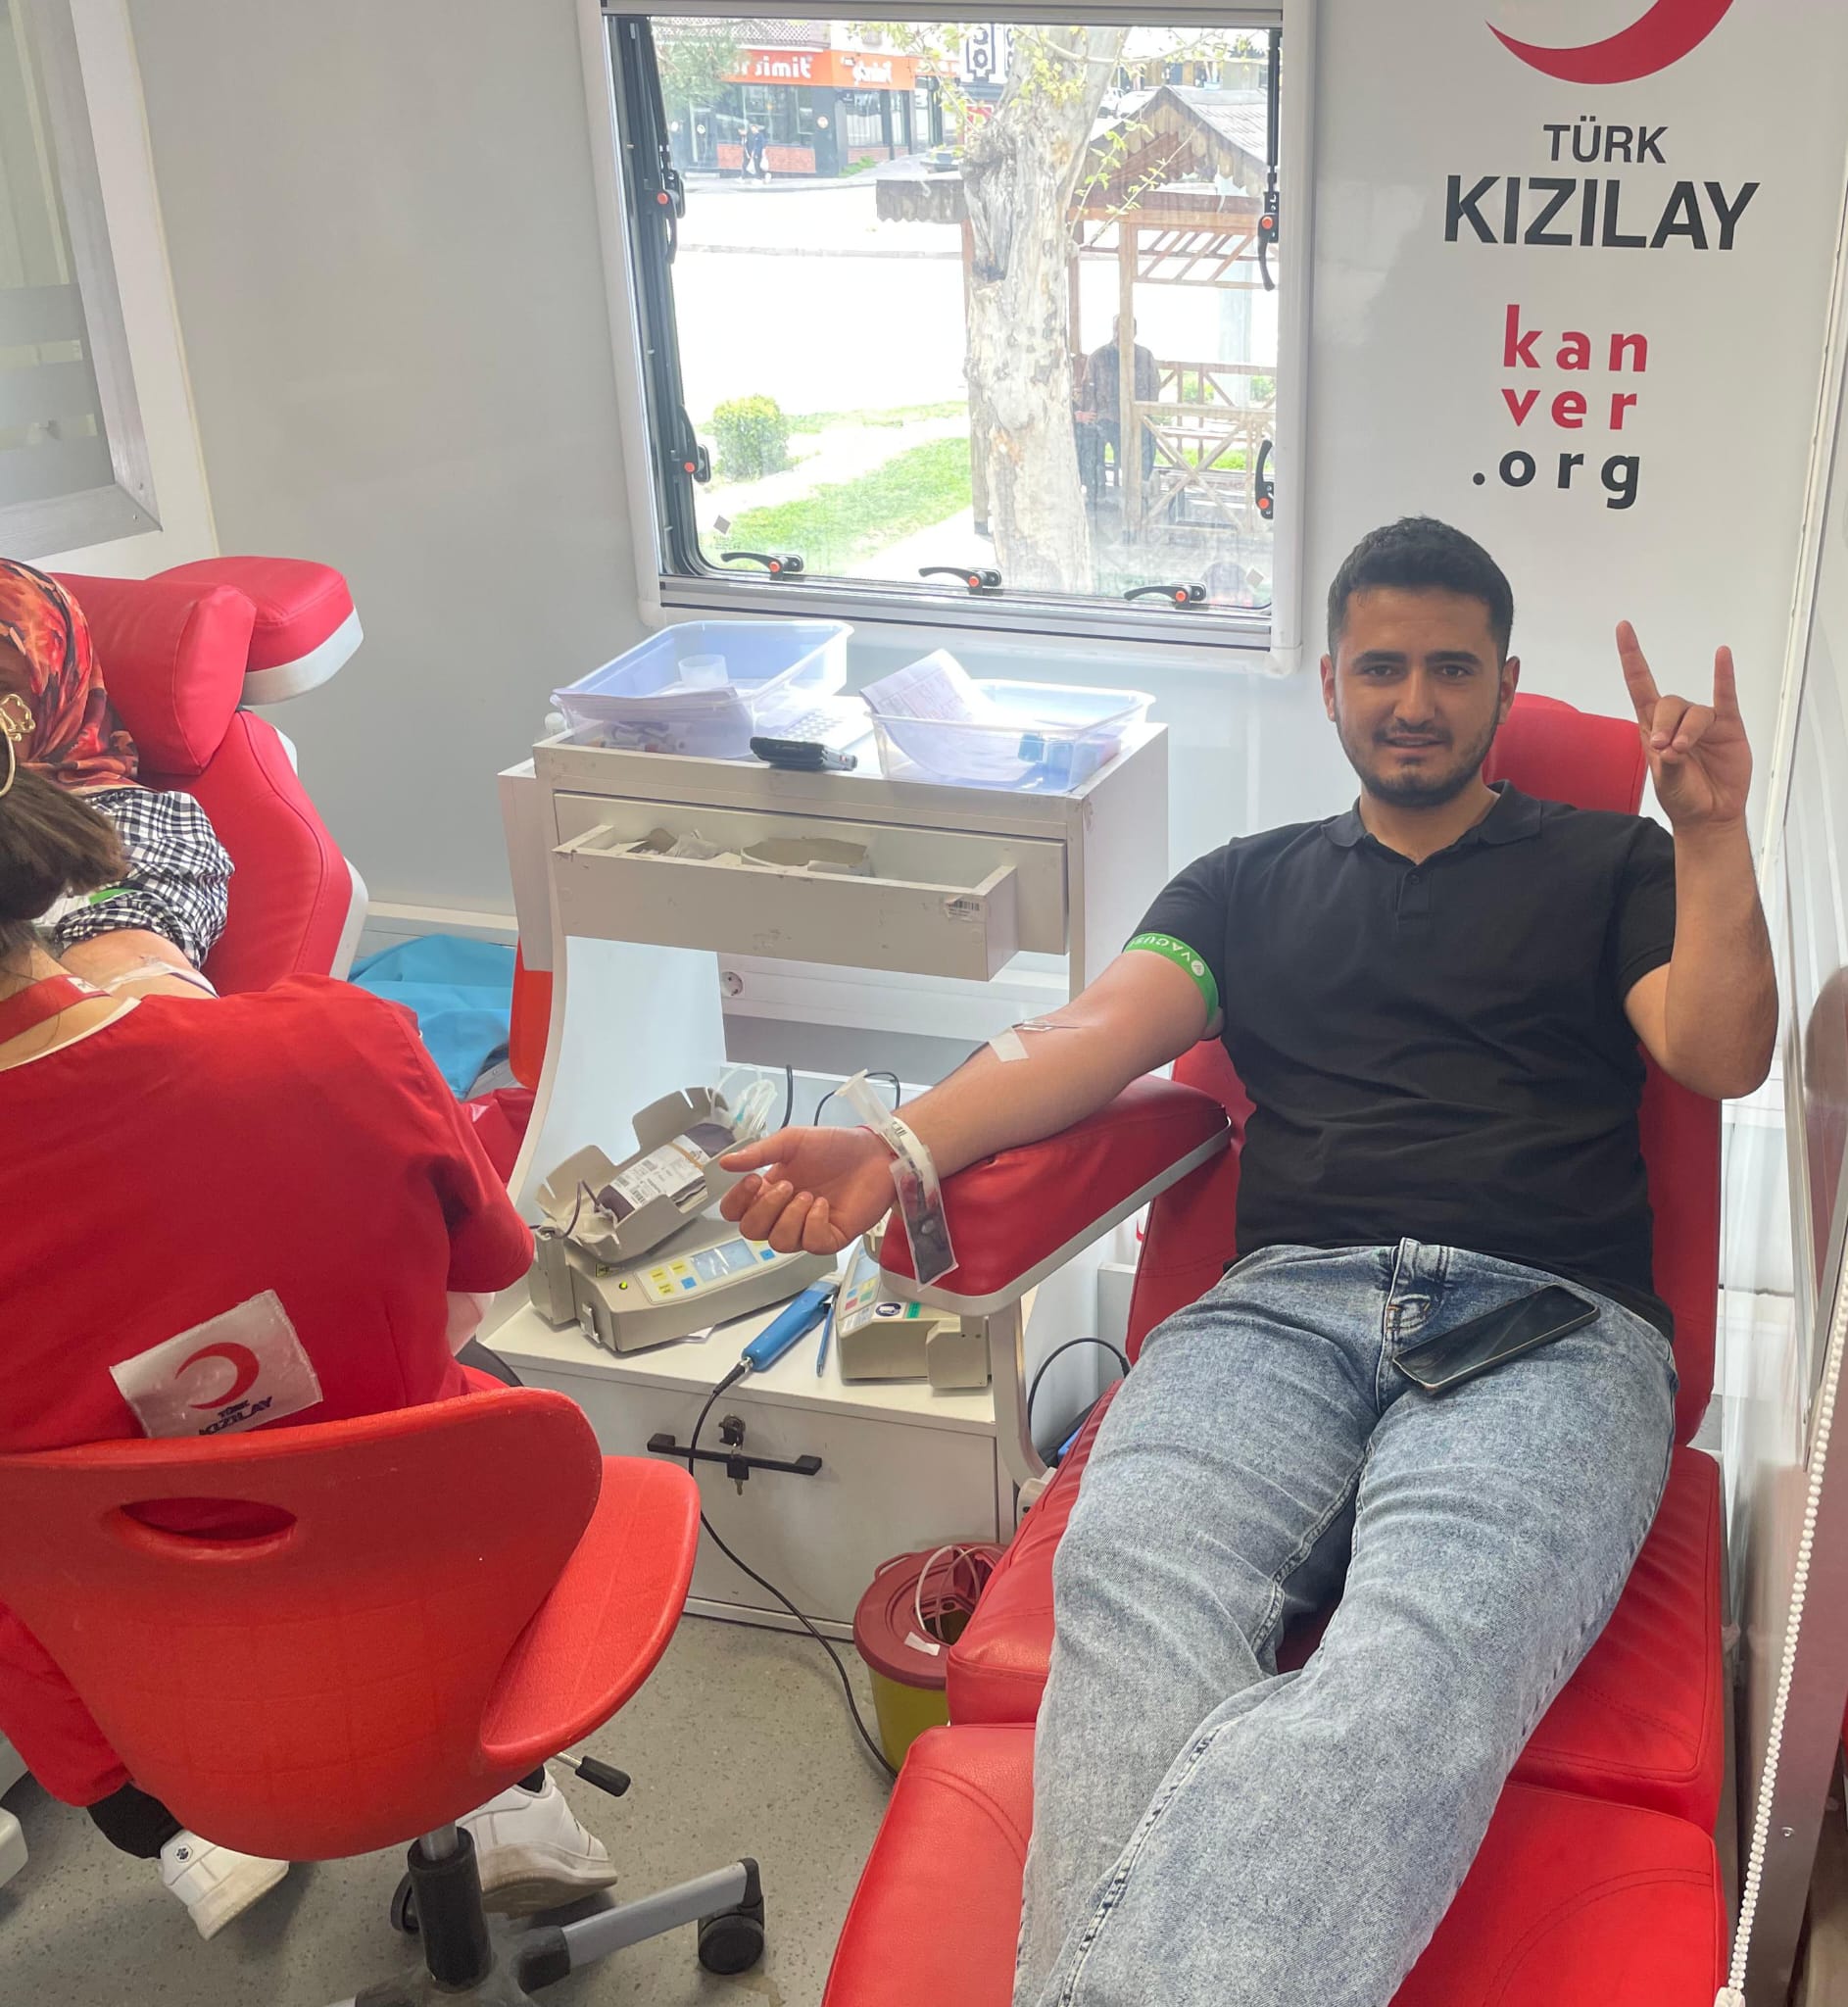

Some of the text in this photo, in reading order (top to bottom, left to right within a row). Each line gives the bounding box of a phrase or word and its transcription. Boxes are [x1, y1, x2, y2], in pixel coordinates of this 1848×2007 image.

[1543, 116, 1668, 163] TÜRK
[1445, 175, 1760, 250] KIZILAY
[1503, 304, 1648, 372] kan
[1501, 388, 1637, 430] ver
[1472, 450, 1640, 510] .org
